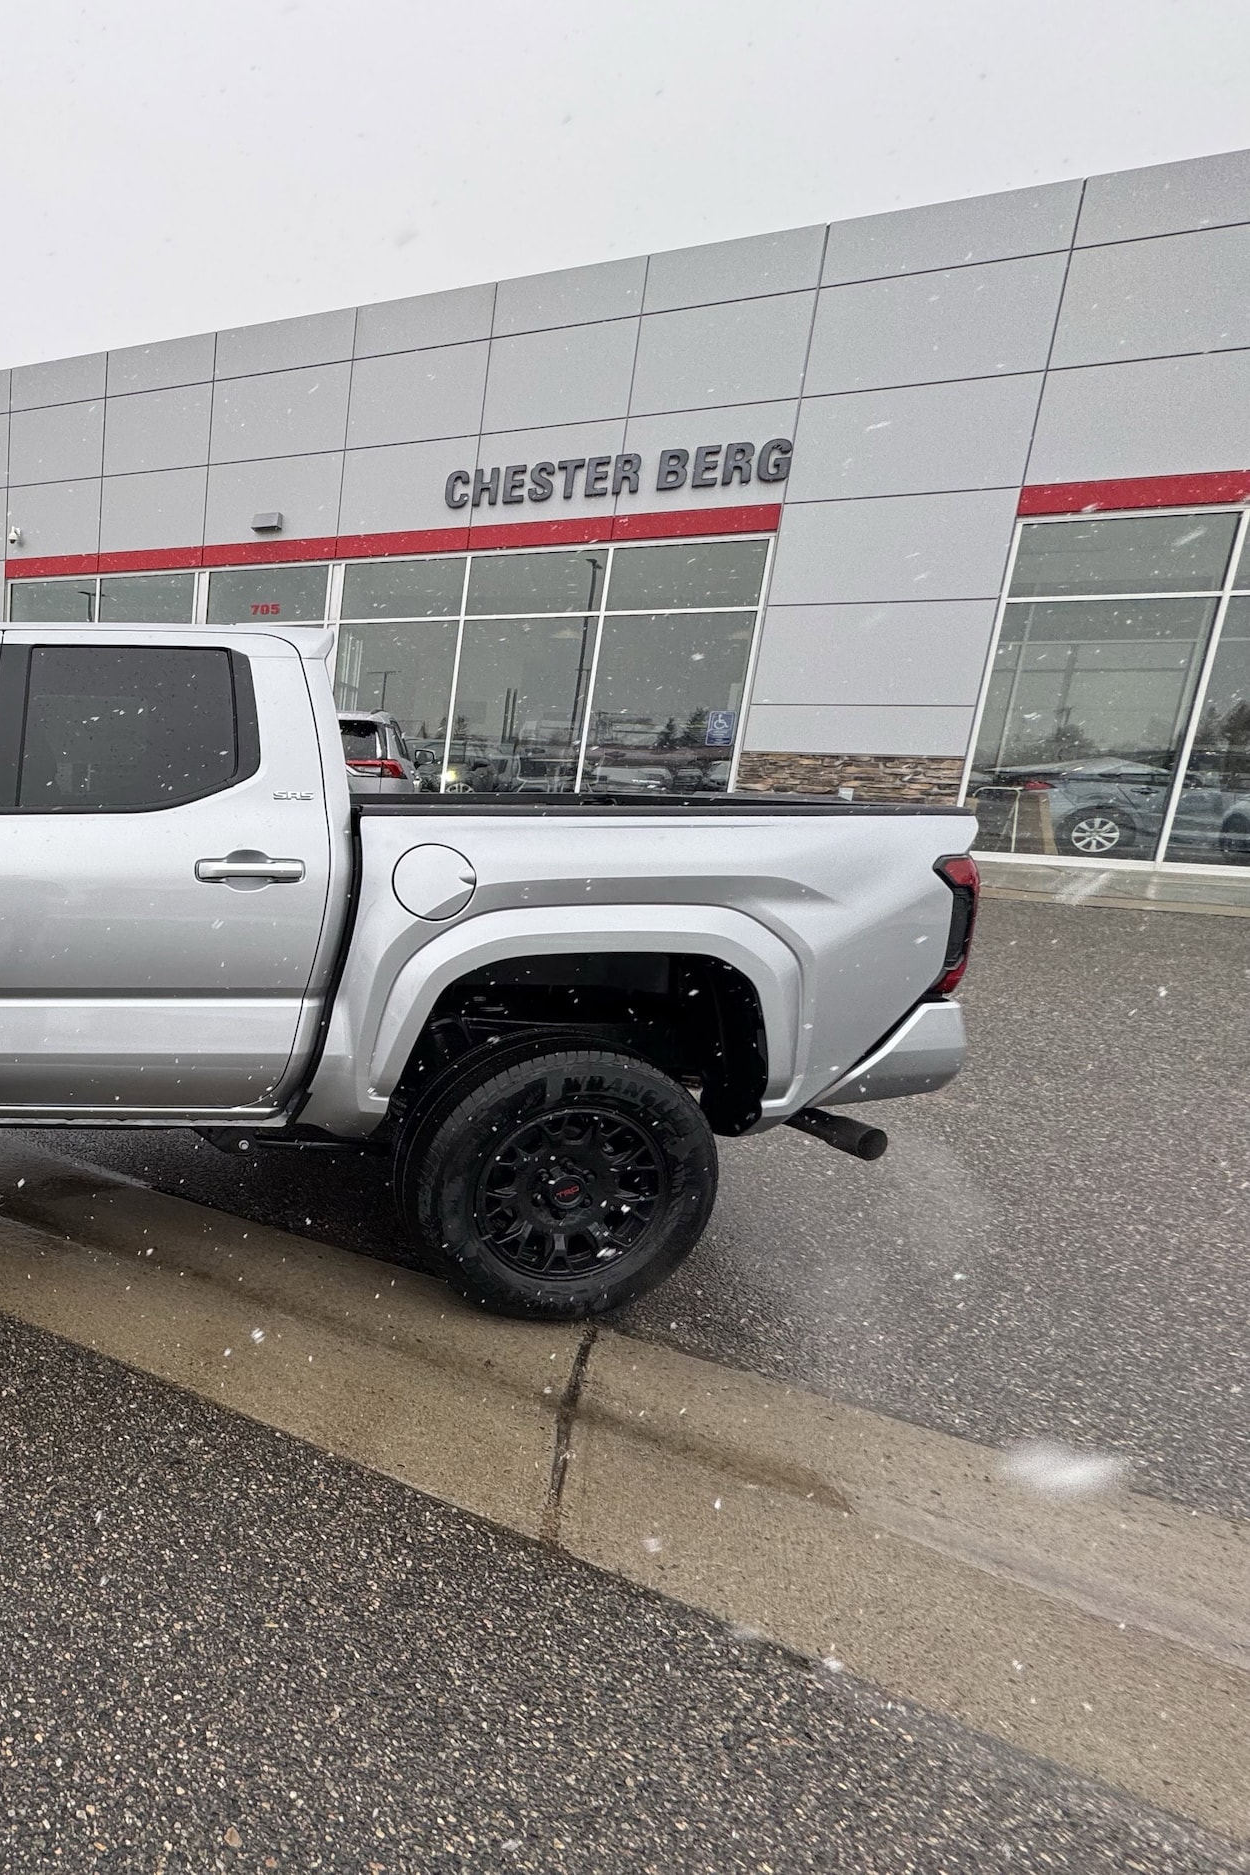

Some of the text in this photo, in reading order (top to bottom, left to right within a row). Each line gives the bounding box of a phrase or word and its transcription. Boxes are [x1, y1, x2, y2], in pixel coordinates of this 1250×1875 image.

[444, 438, 793, 509] CHESTER BERG
[250, 603, 280, 615] 705
